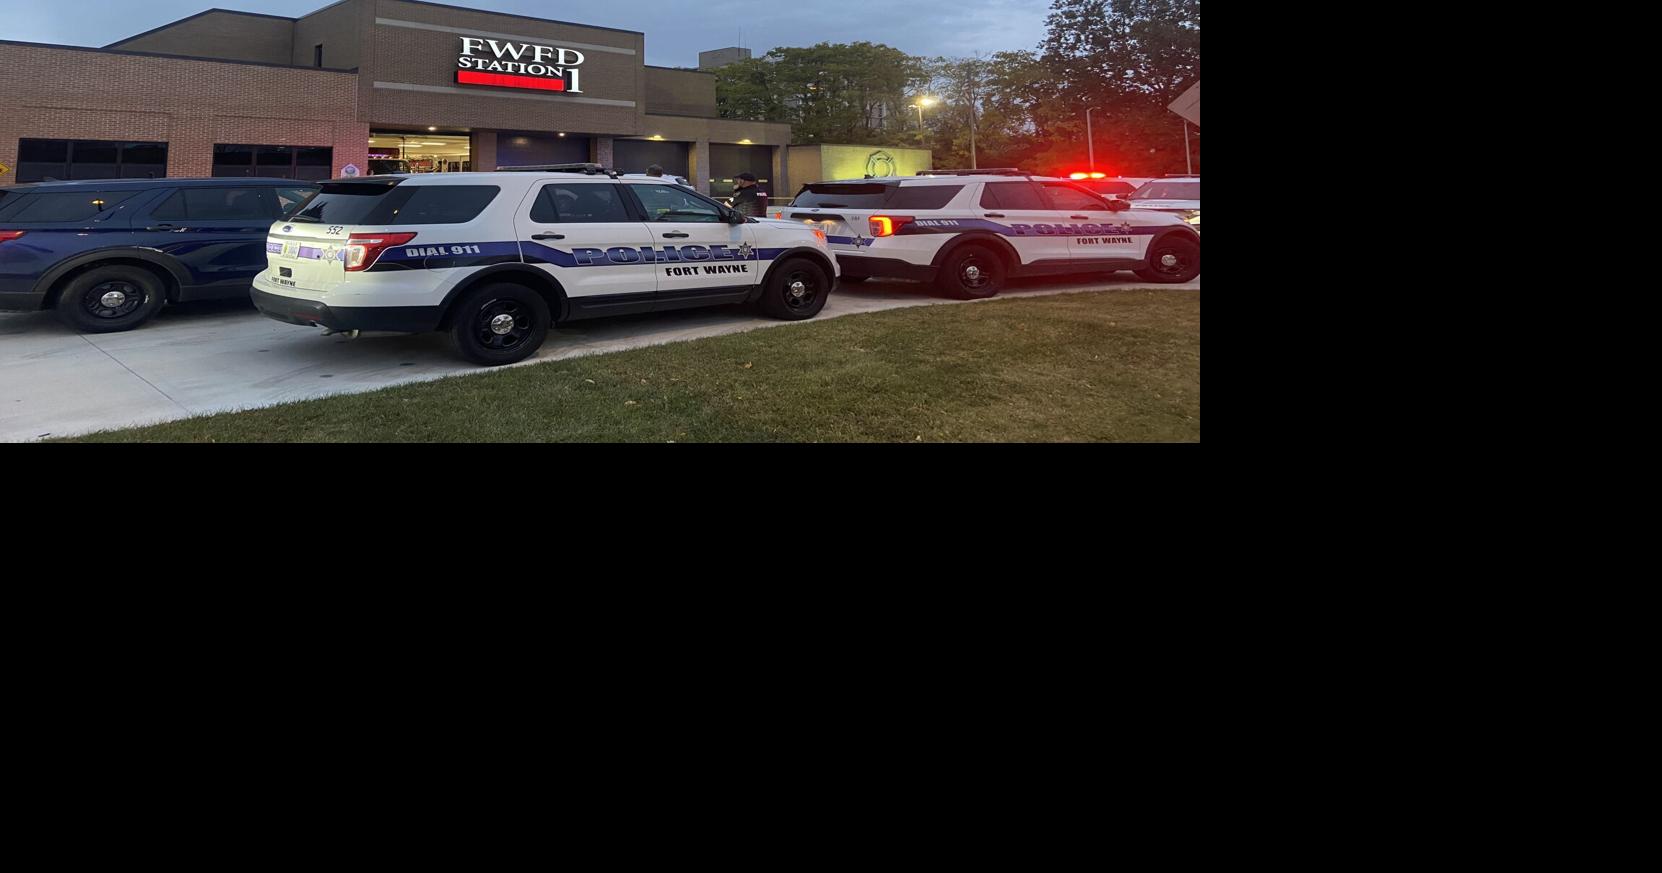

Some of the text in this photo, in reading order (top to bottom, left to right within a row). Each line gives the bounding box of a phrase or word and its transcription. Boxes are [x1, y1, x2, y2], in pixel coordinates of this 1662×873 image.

[460, 36, 585, 66] FWFD
[458, 56, 583, 93] STATION 1
[914, 219, 959, 227] DIAL 911
[1010, 223, 1119, 236] POLICE
[326, 225, 343, 235] 552
[1076, 236, 1133, 245] FORT WAYNE
[406, 245, 481, 258] DIAL 911
[571, 245, 735, 266] POLICE
[665, 264, 749, 277] FORT WAYNE
